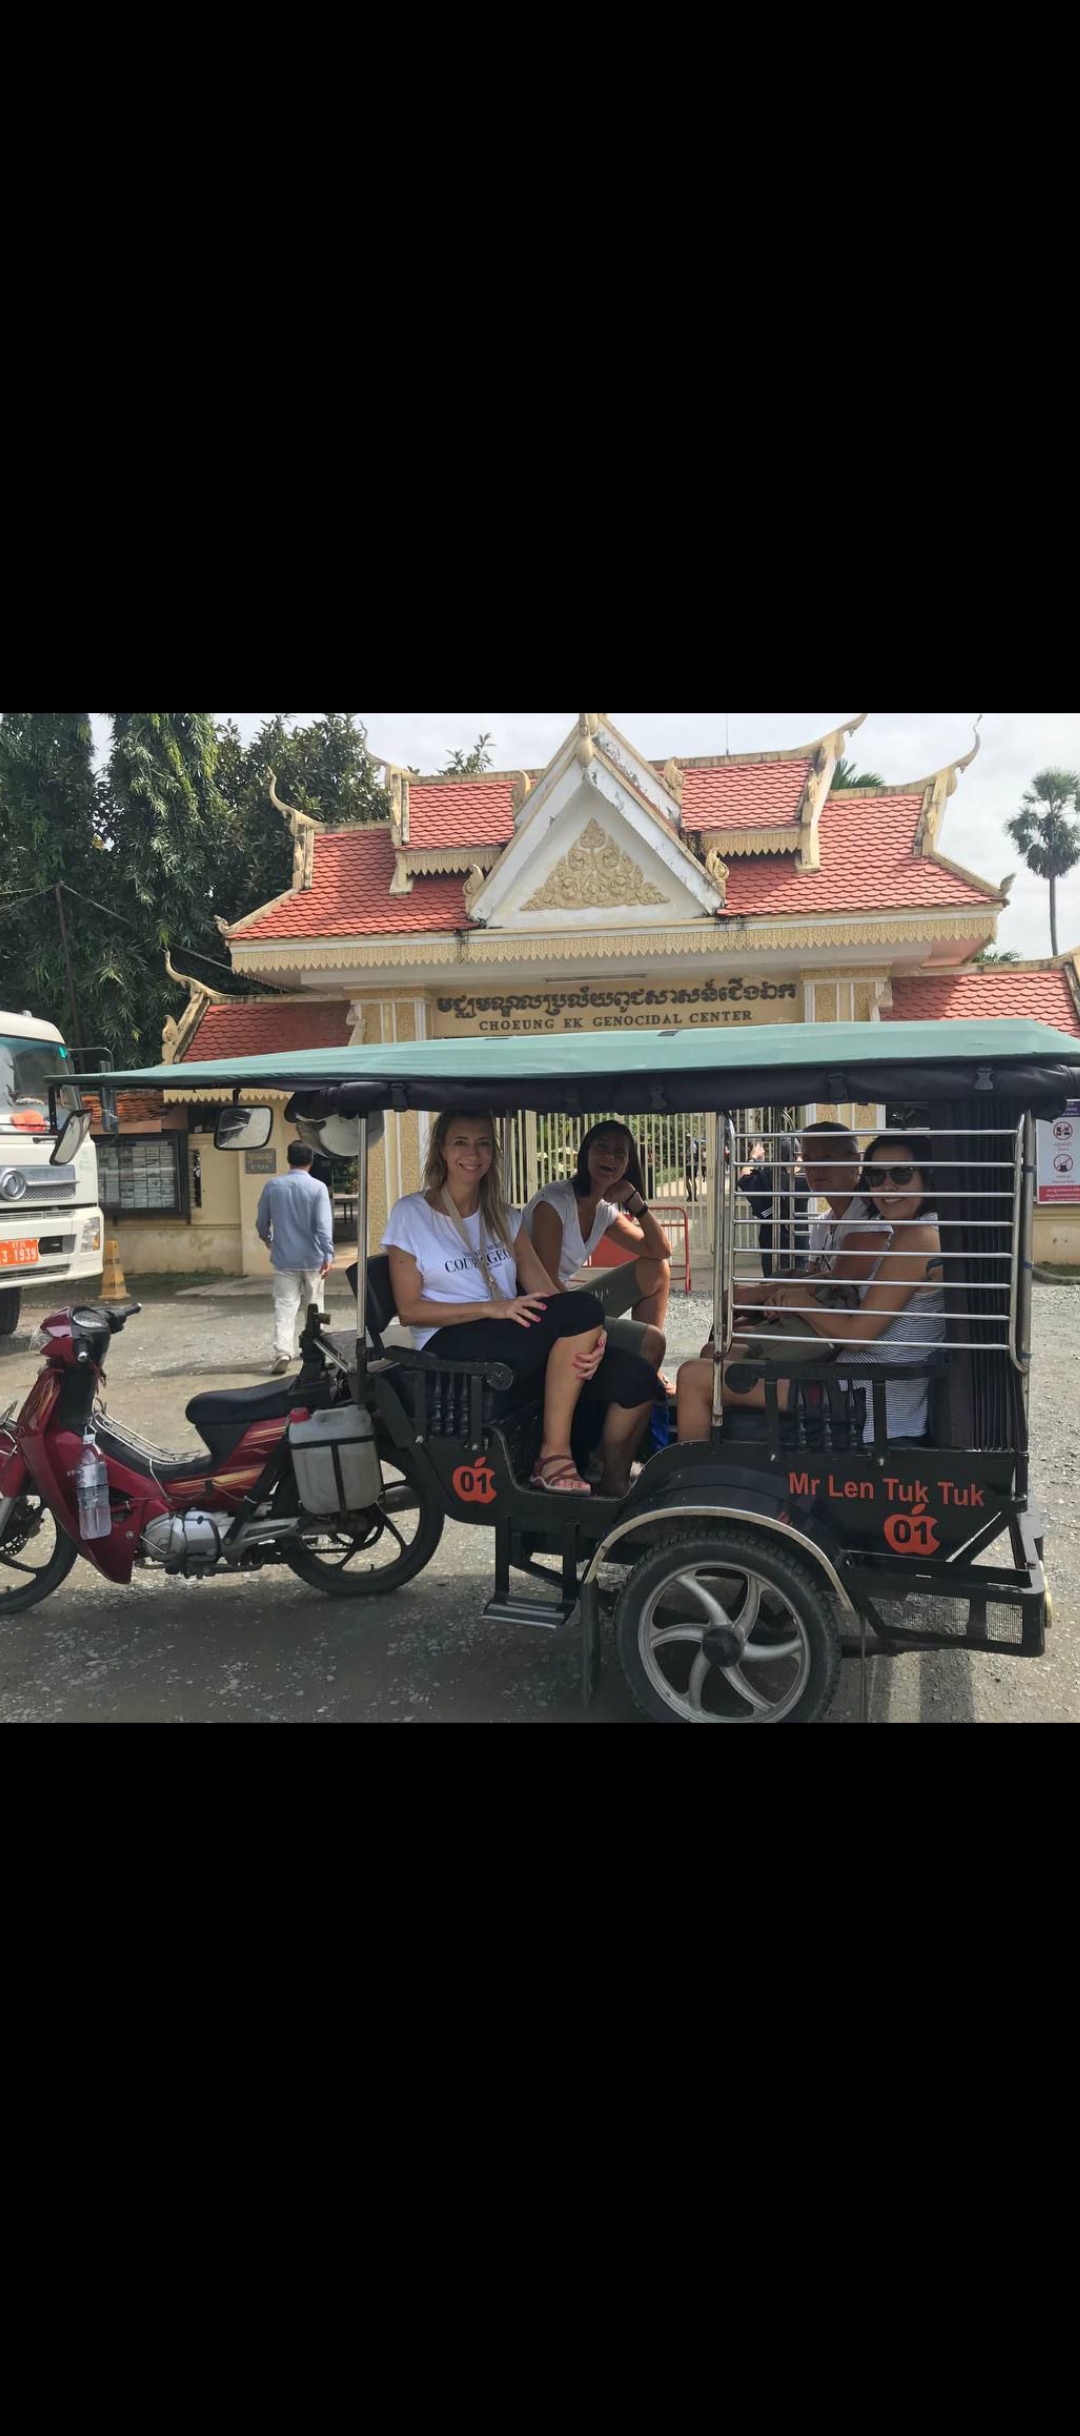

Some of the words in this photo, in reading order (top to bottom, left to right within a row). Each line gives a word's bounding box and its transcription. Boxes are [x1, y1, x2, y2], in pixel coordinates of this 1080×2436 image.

[479, 1018, 555, 1031] CHOEUNG
[563, 1017, 583, 1029] EK
[592, 1013, 683, 1028] GENOCIDAL
[689, 1010, 752, 1024] CENTER
[460, 1471, 488, 1495] 01
[789, 1471, 820, 1496] Mr
[829, 1474, 873, 1499] Len
[883, 1478, 928, 1503] Tuk
[938, 1481, 984, 1506] Tuk
[893, 1519, 928, 1545] 01
